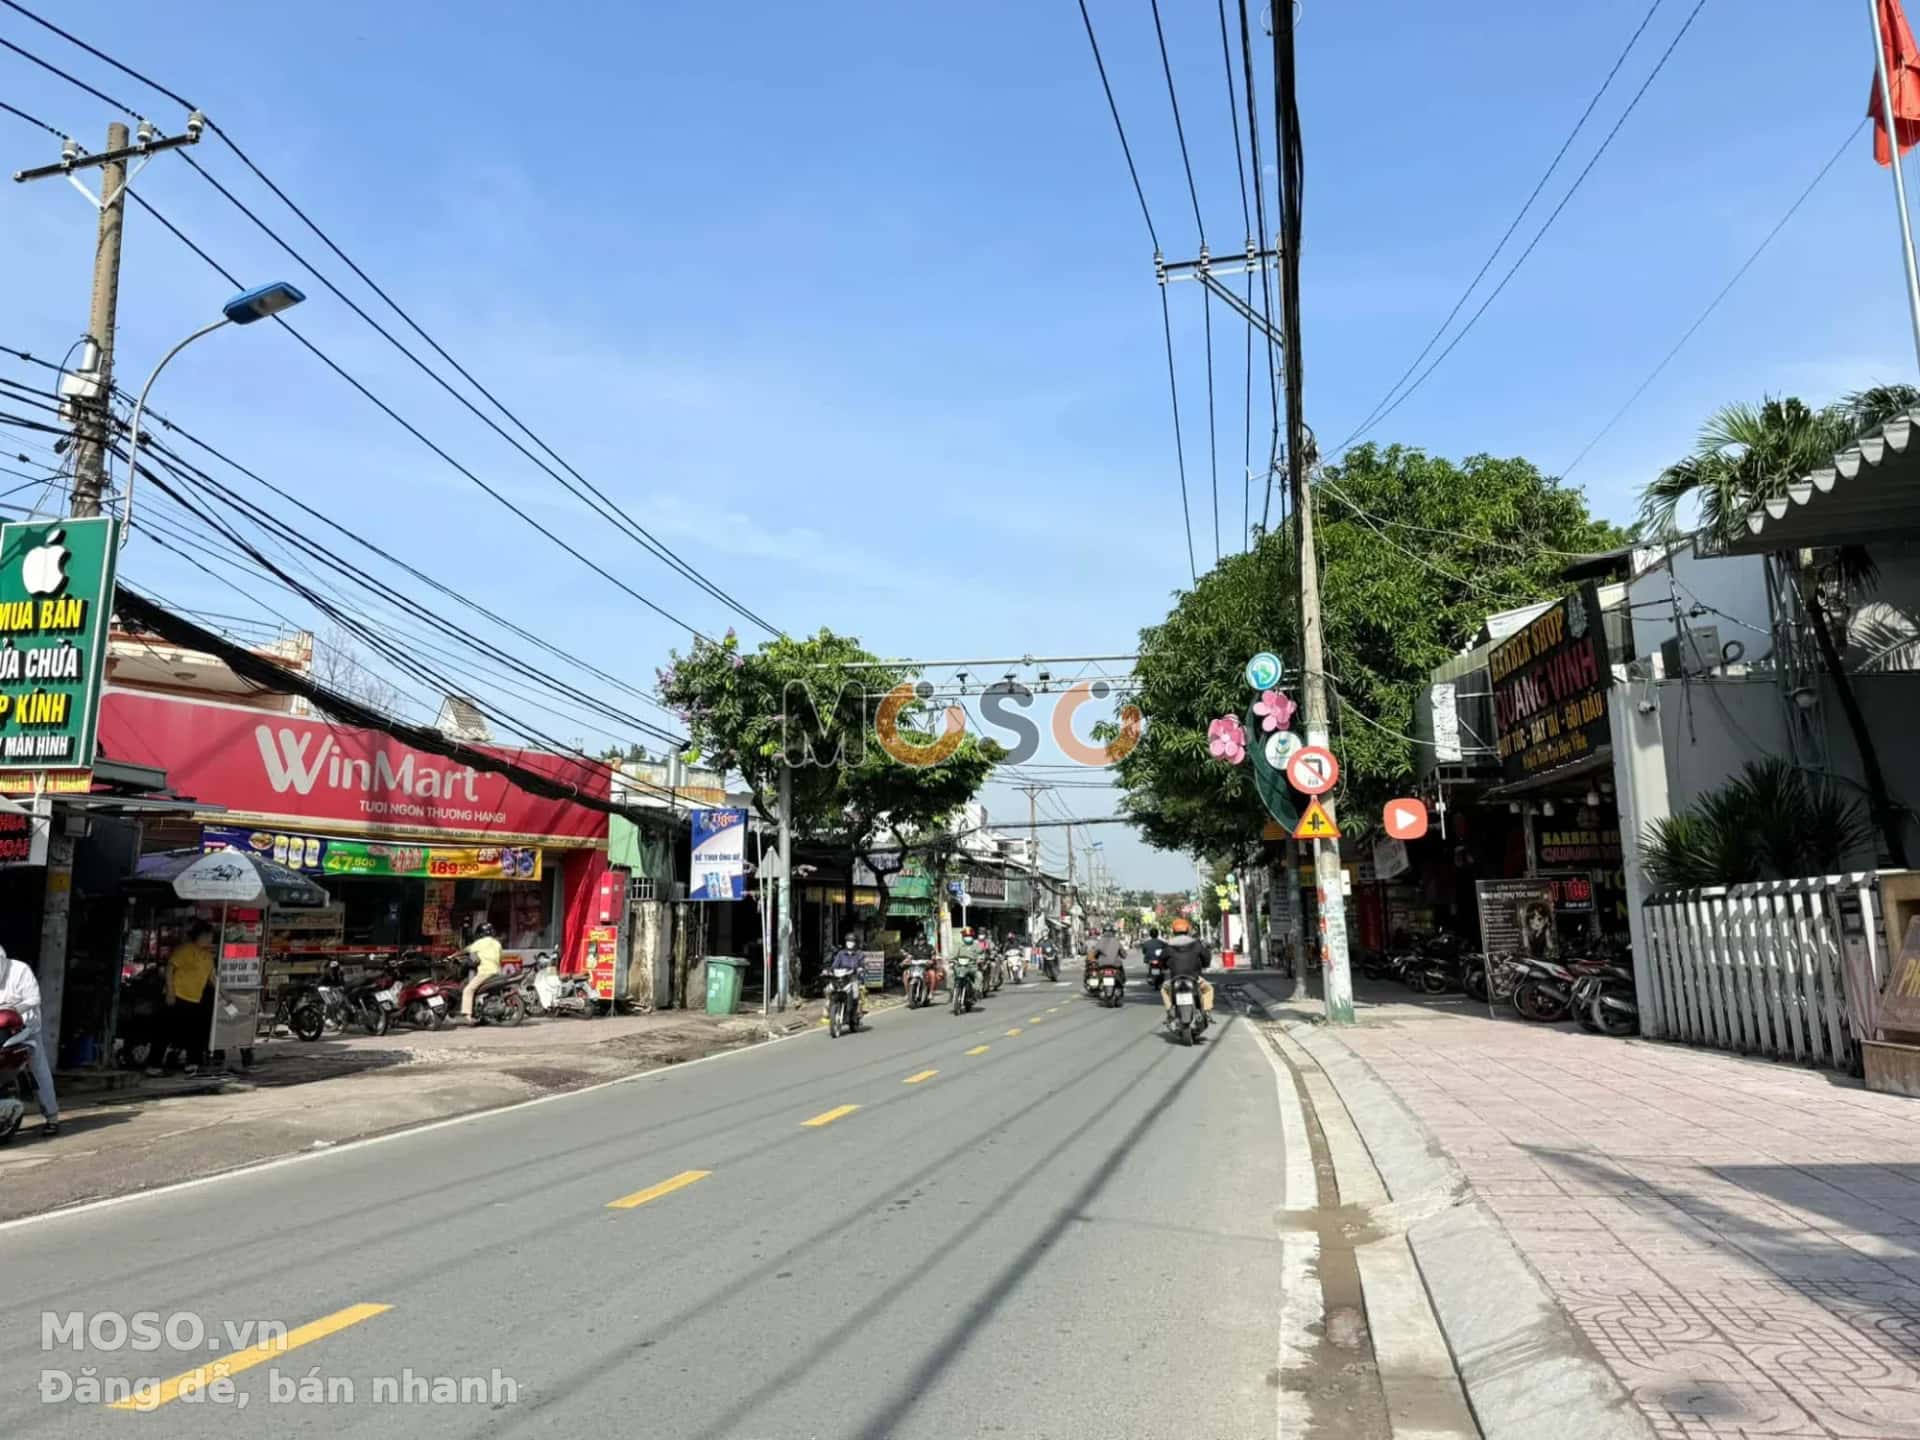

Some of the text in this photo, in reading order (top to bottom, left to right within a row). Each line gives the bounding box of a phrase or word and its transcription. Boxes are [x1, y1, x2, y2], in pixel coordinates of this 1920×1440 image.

[39, 593, 83, 630] BÁN
[1531, 605, 1565, 655] SHOP
[25, 638, 78, 680] CHỮA
[1495, 636, 1600, 731] QUANG VINH
[15, 688, 66, 723] KÍNH
[36, 732, 68, 756] HÌNH
[255, 724, 479, 802] WinMart
[712, 811, 739, 828] Tiger
